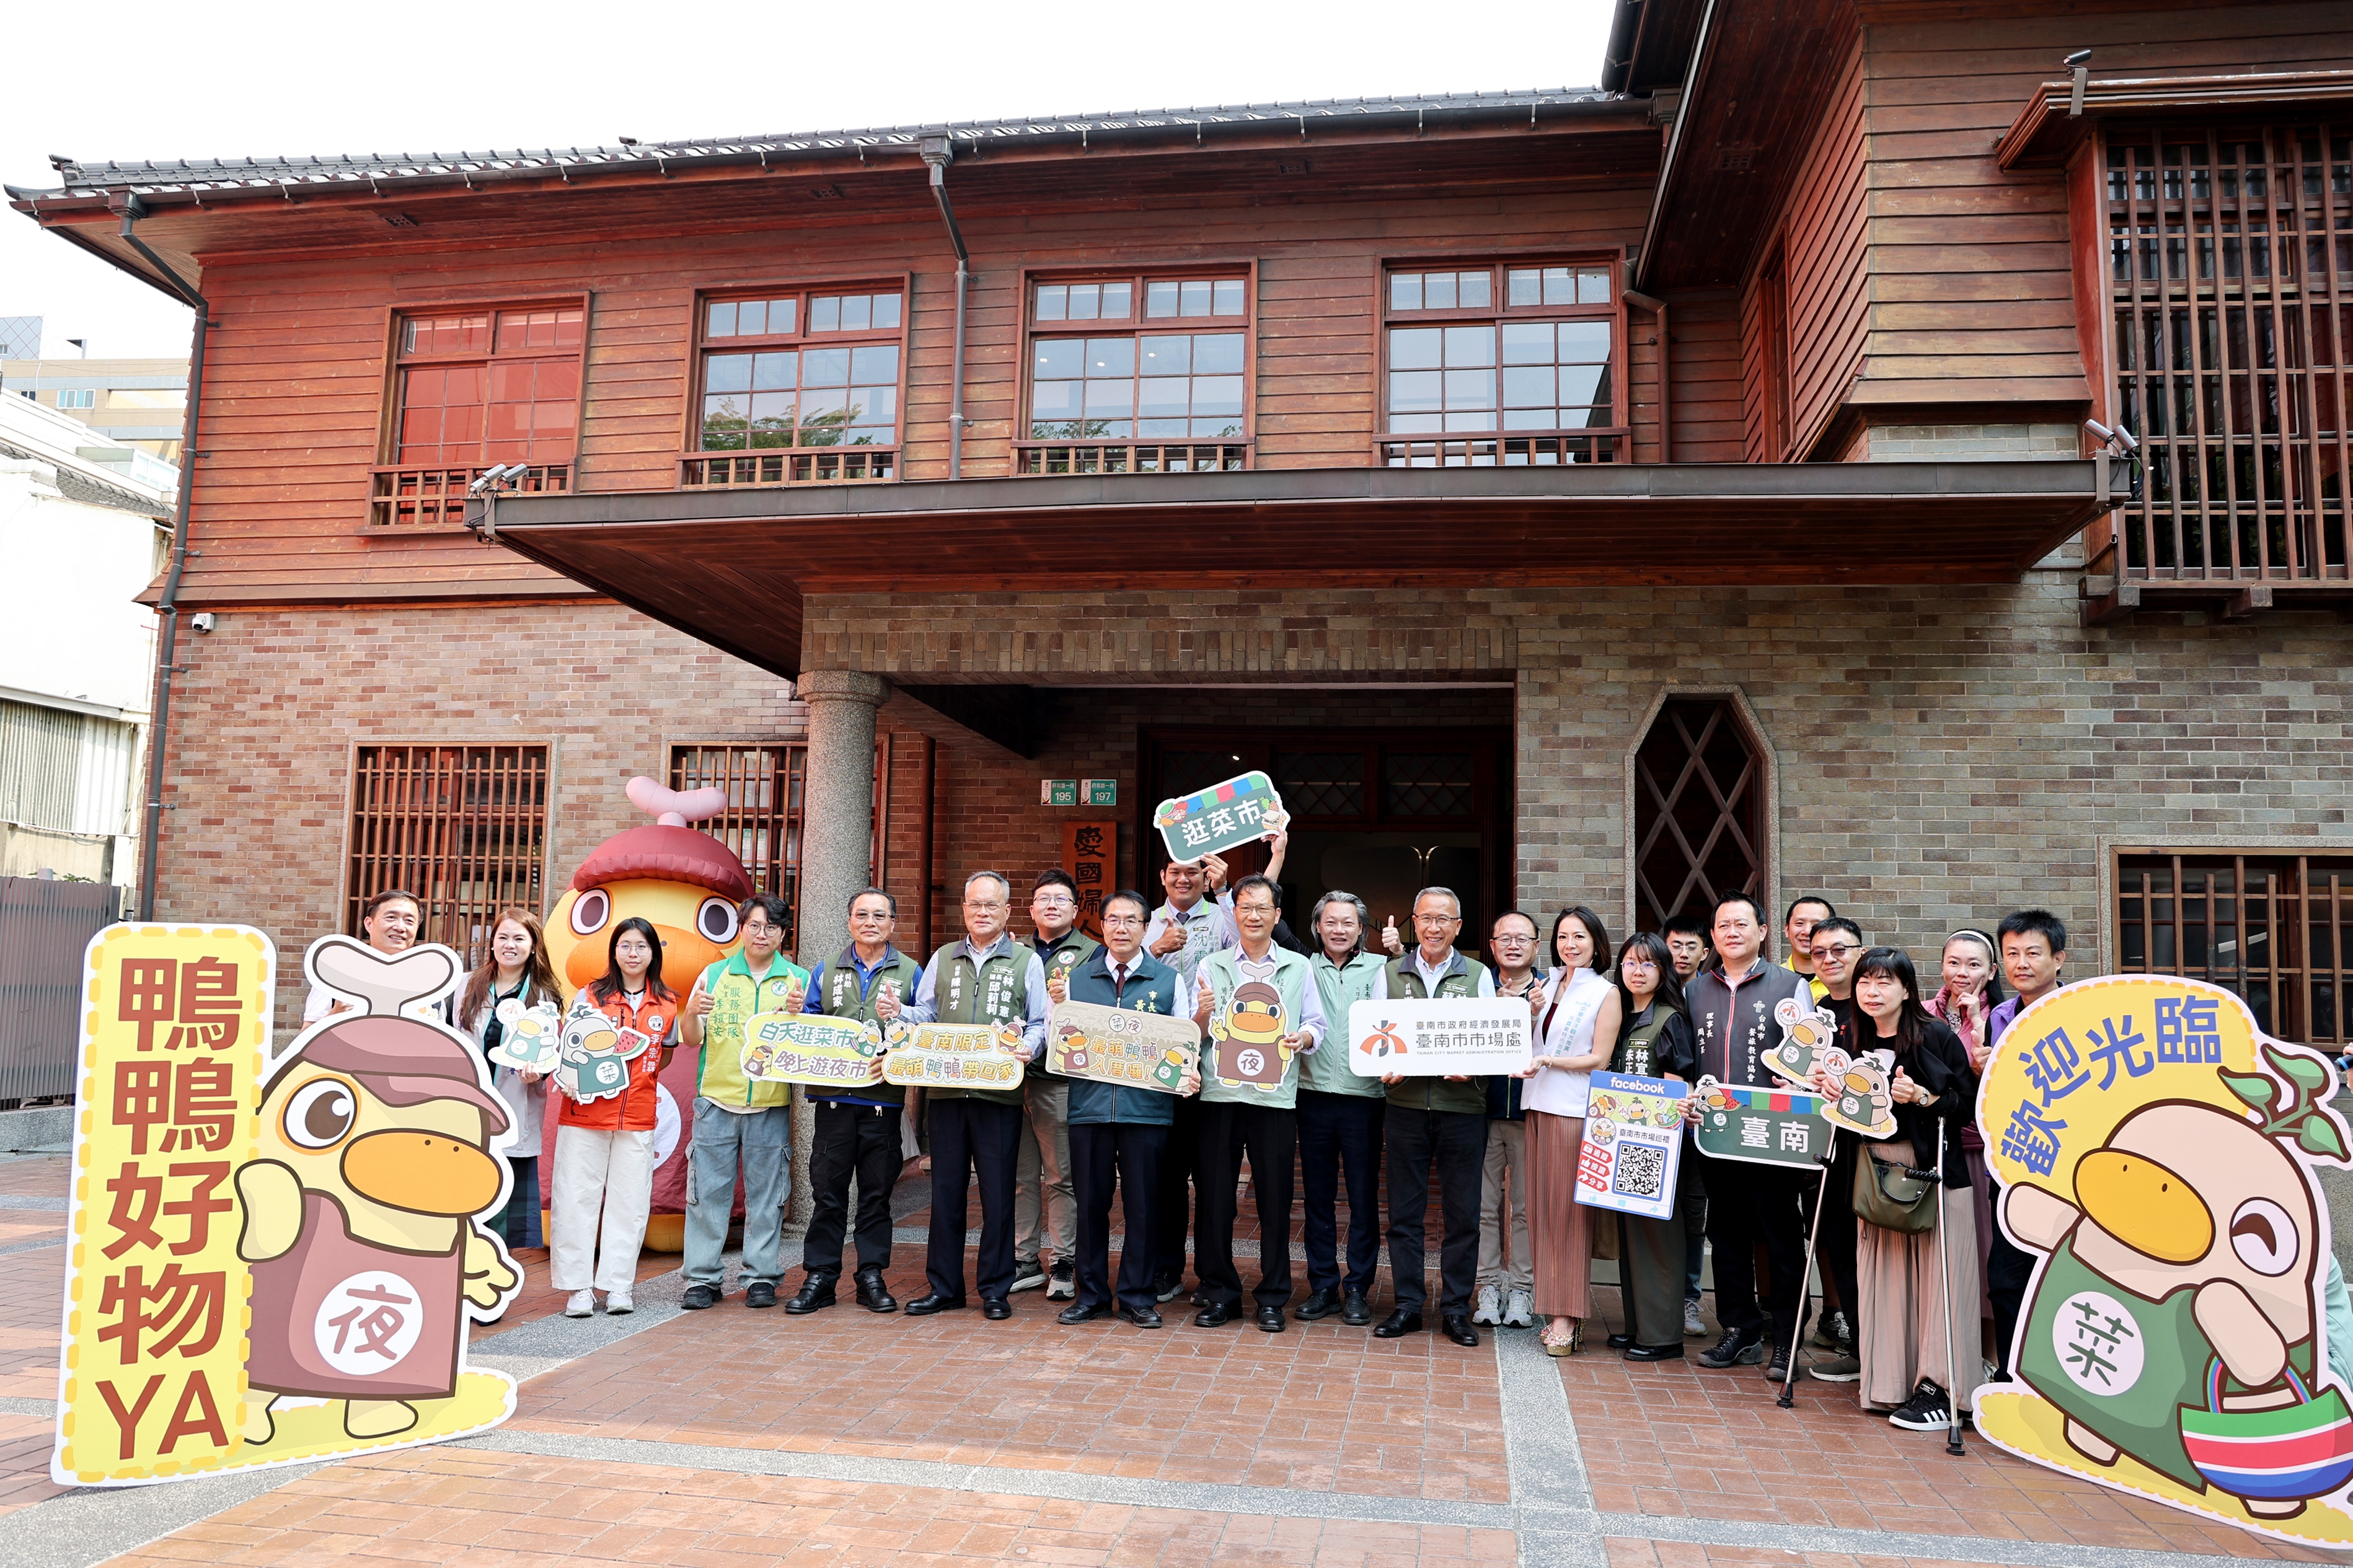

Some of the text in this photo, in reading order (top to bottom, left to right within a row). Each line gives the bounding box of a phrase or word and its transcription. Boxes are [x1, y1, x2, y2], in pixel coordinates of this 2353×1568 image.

[1055, 792, 1071, 801] 195
[1095, 792, 1111, 801] 197
[1181, 798, 1260, 848] 逛菜市
[832, 973, 844, 1008] 林成家
[844, 973, 852, 988] 特助
[950, 977, 961, 1010] 陳明才
[986, 981, 1001, 1015] 邱莉莉
[999, 976, 1014, 1018] 林俊憲
[1148, 990, 1158, 1013] 市長
[713, 998, 725, 1037] 李鎧安
[727, 987, 741, 1038] 服務團隊
[1416, 1019, 1522, 1030] 臺南市政府經濟發展局
[759, 1021, 855, 1047] 白天逛菜市
[1128, 1020, 1141, 1033] 夜
[1706, 1012, 1714, 1038] 理事長
[1757, 1015, 1767, 1041] 台南市
[916, 1029, 991, 1051] 臺南限定
[1090, 1036, 1159, 1060] 最萌鴨鴨
[1416, 1032, 1522, 1048] 臺南市市場處
[647, 1033, 660, 1072] 李宗霖
[774, 1050, 868, 1078] 晚上遊夜市
[1074, 1054, 1085, 1064] 夜
[1240, 1052, 1260, 1072] 夜
[1635, 1049, 1649, 1077] 林宜
[1747, 1028, 1757, 1082] 餐旅教育協會
[1785, 1047, 1798, 1062] 菜
[599, 1064, 616, 1081] 菜
[888, 1056, 1015, 1081] 最萌鴨鴨帶回家
[1159, 1067, 1171, 1078] 菜
[1610, 1076, 1665, 1094] facebook
[2001, 995, 2223, 1177] 歡迎光臨
[1845, 1098, 1858, 1112] 菜
[1715, 1115, 1725, 1125] 菜
[1619, 1129, 1670, 1144] 臺南市市場巡禮
[1741, 1117, 1810, 1153] 臺南
[1593, 1148, 1609, 1161] 追蹤
[1590, 1162, 1607, 1176] 按讚
[1588, 1178, 1605, 1189] 分享
[95, 957, 242, 1461] 鴨鴨好物YA
[328, 1285, 412, 1362] 夜
[2066, 1301, 2134, 1387] 菜
